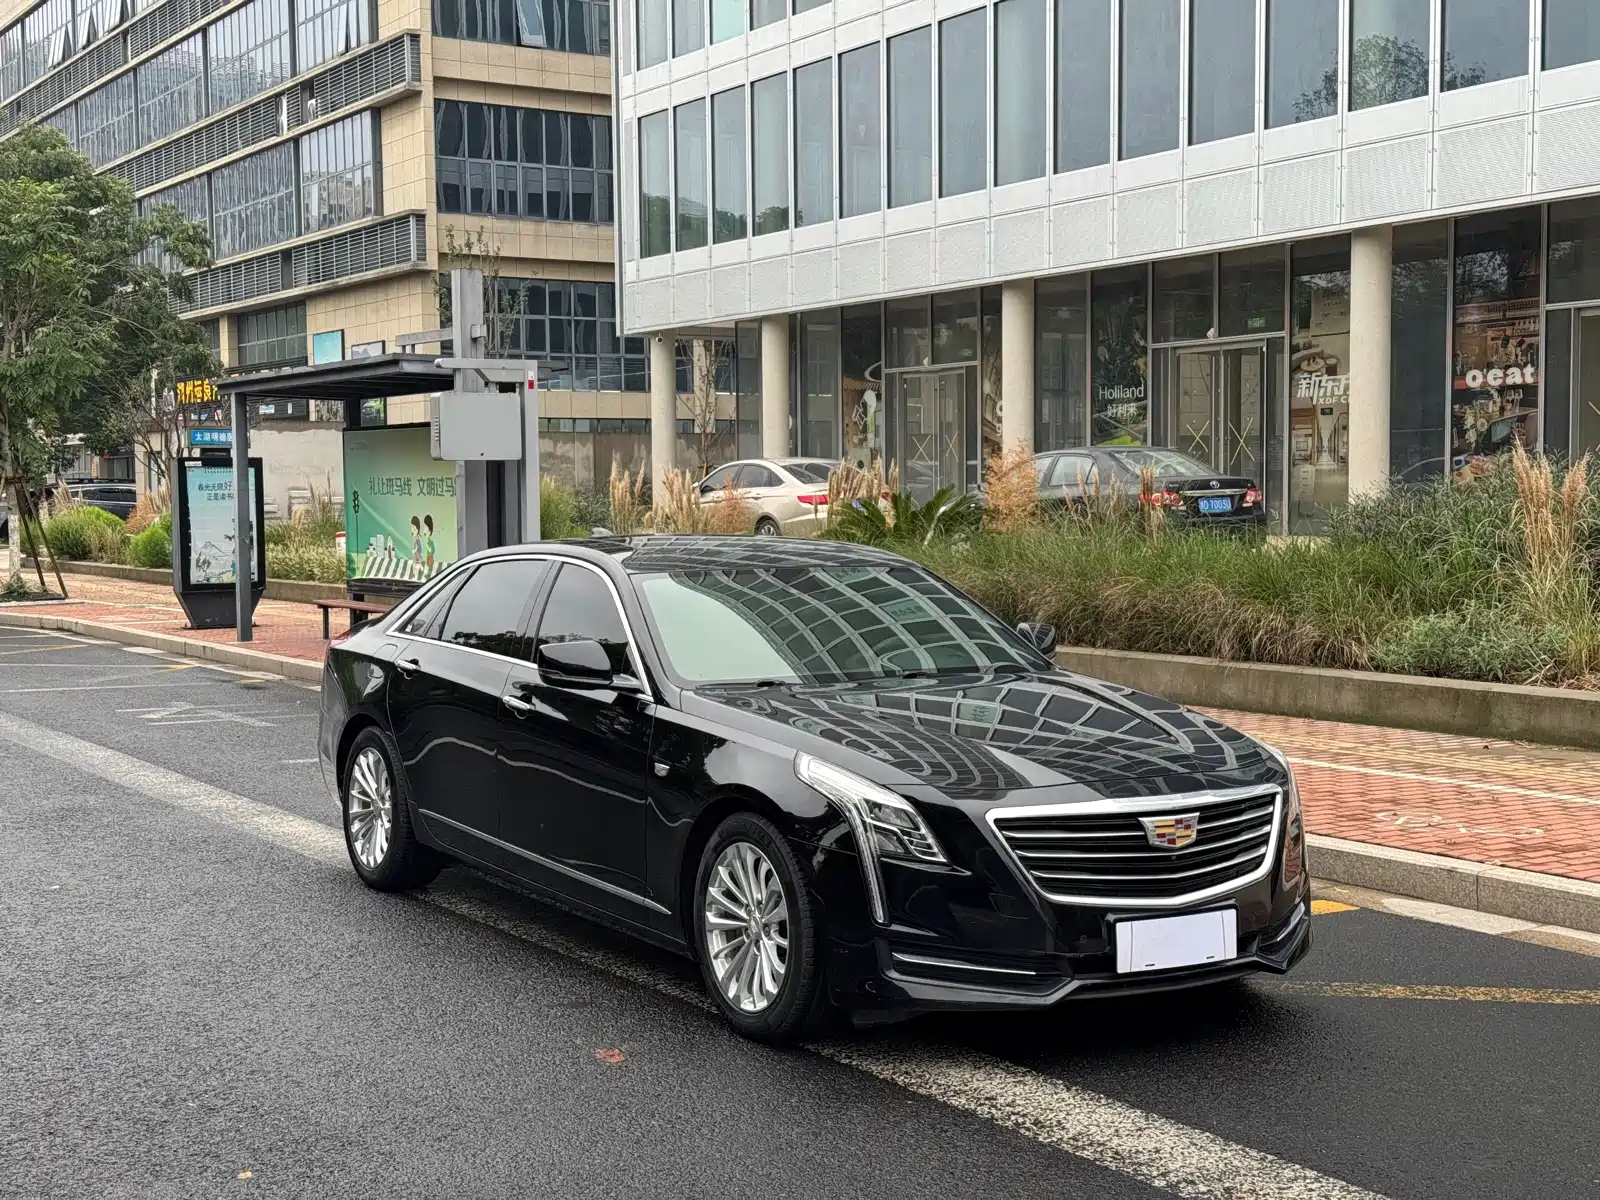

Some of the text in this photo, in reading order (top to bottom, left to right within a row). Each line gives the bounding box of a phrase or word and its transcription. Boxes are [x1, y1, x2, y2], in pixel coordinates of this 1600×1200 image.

[1099, 384, 1144, 400] Holiland
[1318, 396, 1338, 404] XDF
[1106, 403, 1137, 419] 好利来
[368, 476, 457, 497] 礼让斑马线 文明过马
